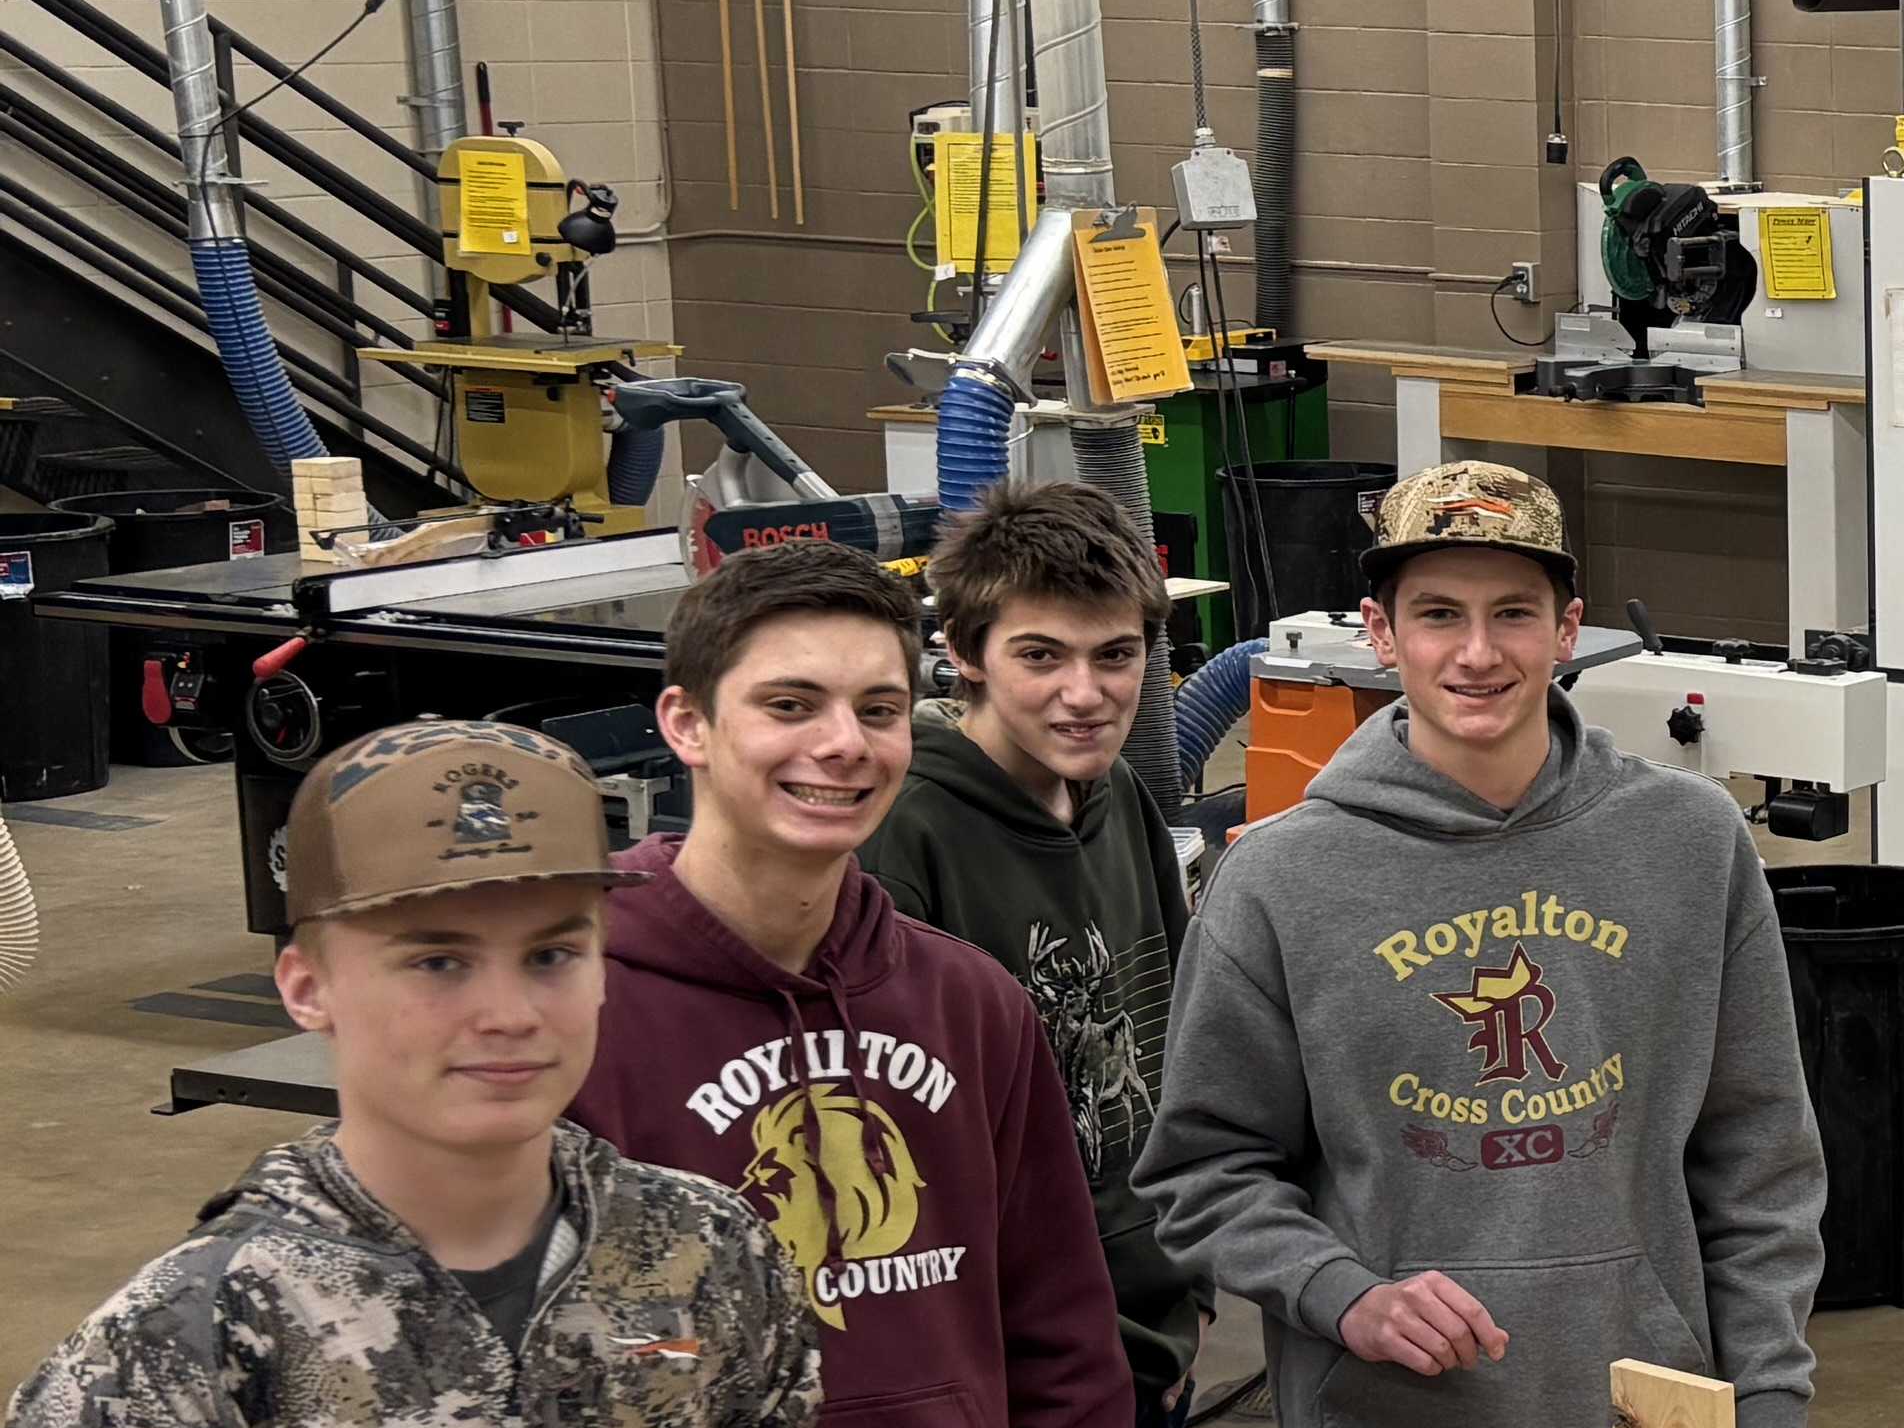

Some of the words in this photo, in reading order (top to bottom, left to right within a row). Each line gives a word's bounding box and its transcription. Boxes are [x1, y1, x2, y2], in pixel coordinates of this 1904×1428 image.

[1673, 201, 1704, 236] HITACHI
[1373, 891, 1629, 982] Royalton
[1389, 1073, 1488, 1124] Cross
[1492, 1130, 1555, 1164] XC
[816, 1246, 966, 1302] COUNTRY
